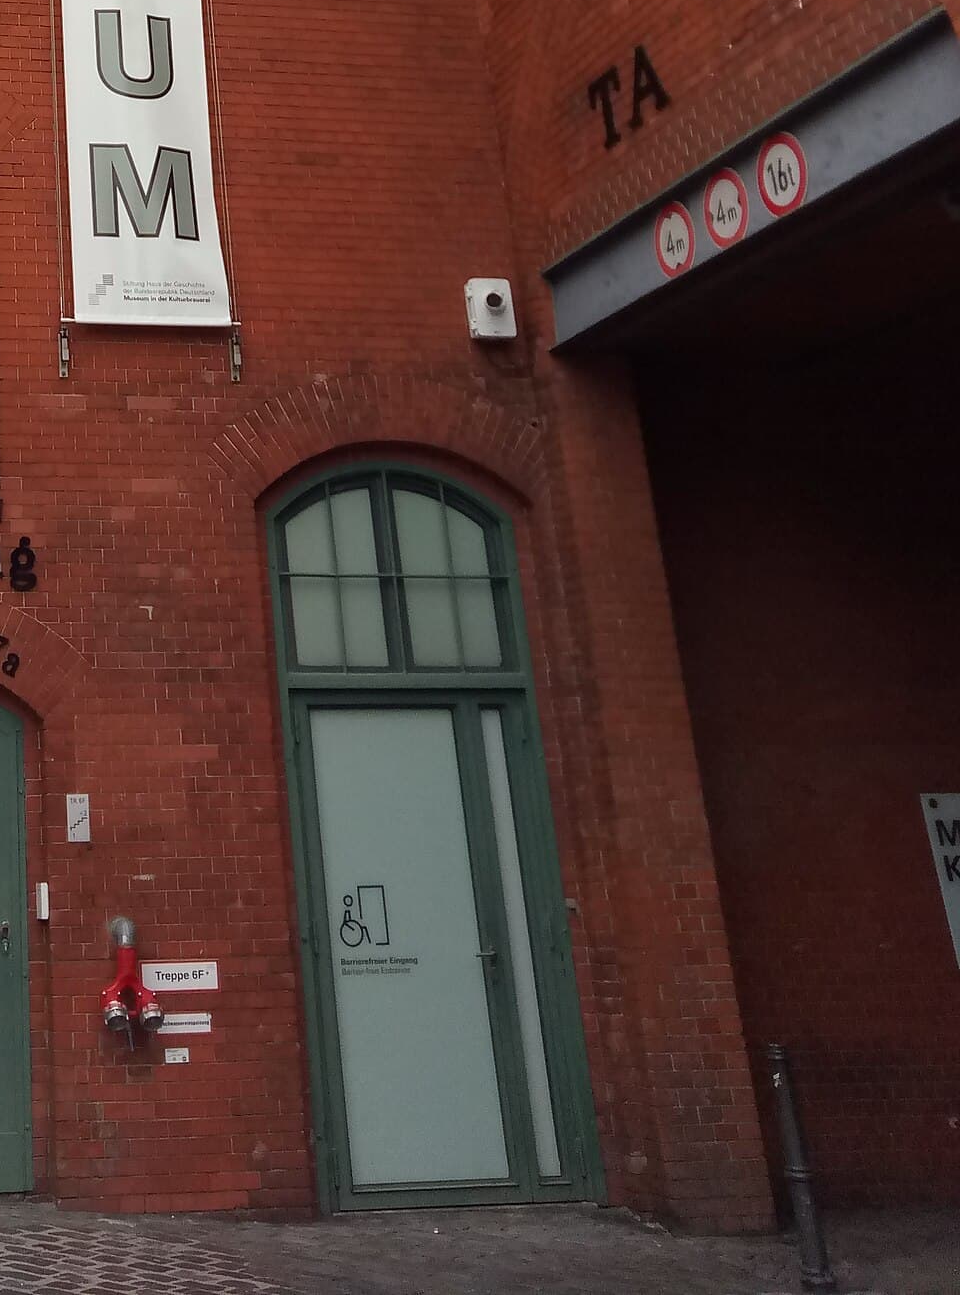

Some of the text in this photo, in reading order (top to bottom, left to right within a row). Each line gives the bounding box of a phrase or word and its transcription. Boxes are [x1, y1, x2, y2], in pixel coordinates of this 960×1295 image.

[767, 157, 796, 196] 16t
[389, 957, 418, 965] Eingang
[155, 969, 205, 983] Treppe 6F
